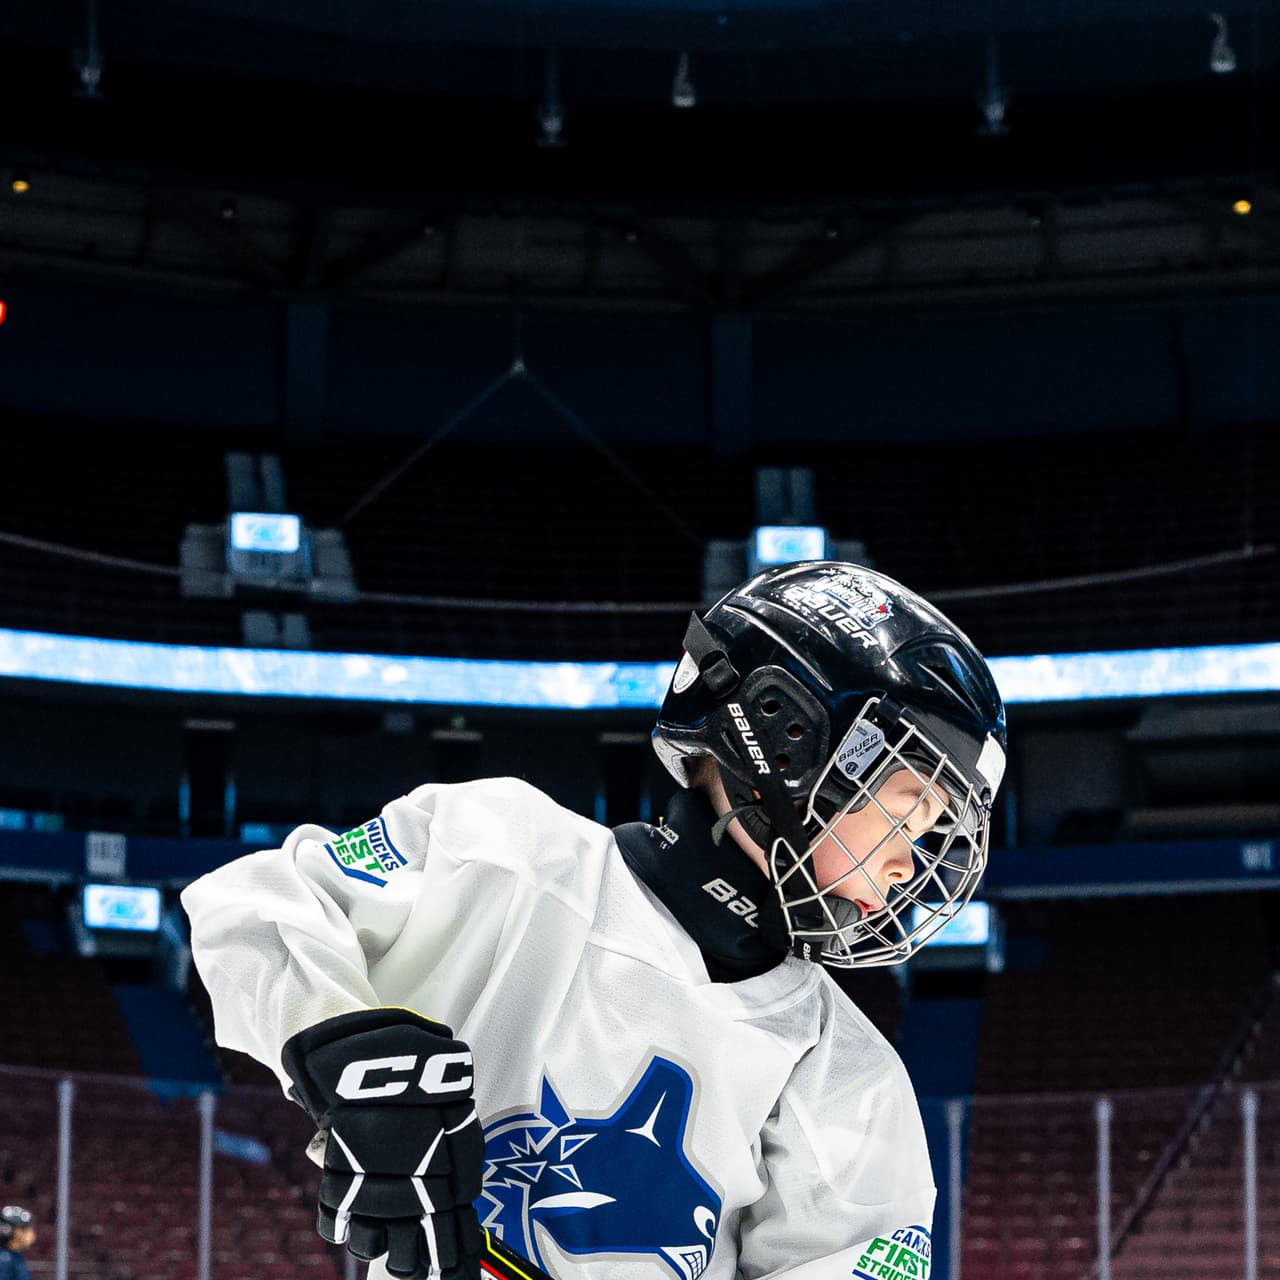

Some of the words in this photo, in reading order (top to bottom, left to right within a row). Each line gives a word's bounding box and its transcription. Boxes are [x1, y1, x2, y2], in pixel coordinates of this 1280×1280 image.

[728, 703, 771, 775] BAUER
[364, 820, 400, 872] NUCKS
[1242, 841, 1272, 871] WE
